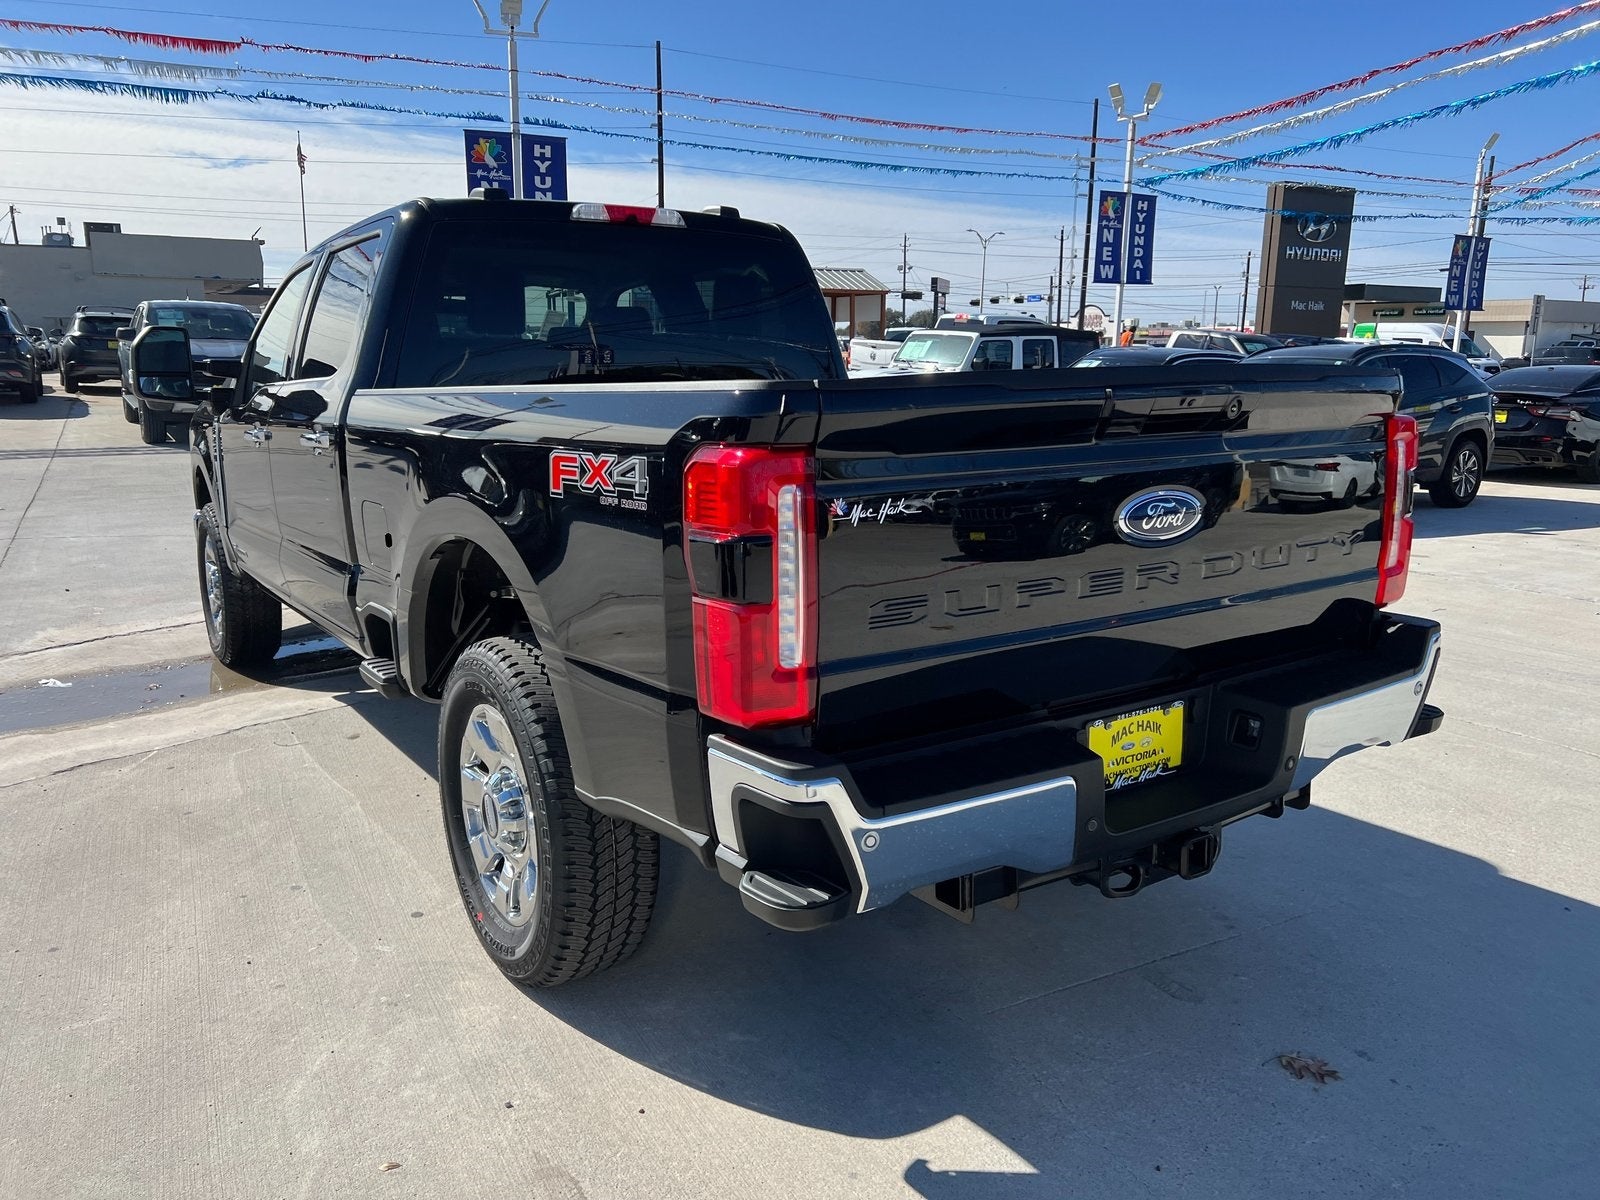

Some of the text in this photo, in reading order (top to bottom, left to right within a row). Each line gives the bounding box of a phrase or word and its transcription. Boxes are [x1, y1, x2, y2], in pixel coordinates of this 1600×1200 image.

[1100, 228, 1115, 279] NEW
[1133, 200, 1149, 280] HYUNDAI
[1285, 246, 1342, 263] HYUNDAI
[1447, 265, 1461, 306] NEW
[1470, 241, 1486, 307] HYUNDAI
[1290, 300, 1325, 311] Mac Haik
[549, 449, 649, 500] FX4
[600, 496, 648, 511] OFF ROAD
[843, 498, 912, 528] Mac Haik
[1142, 502, 1186, 530] Ford
[868, 530, 1364, 630] SUPER DUTY
[1111, 721, 1135, 748] MAC
[1136, 719, 1163, 736] HAIK
[1114, 748, 1158, 767] VICTORIA
[1110, 764, 1168, 790] Mac Haik
